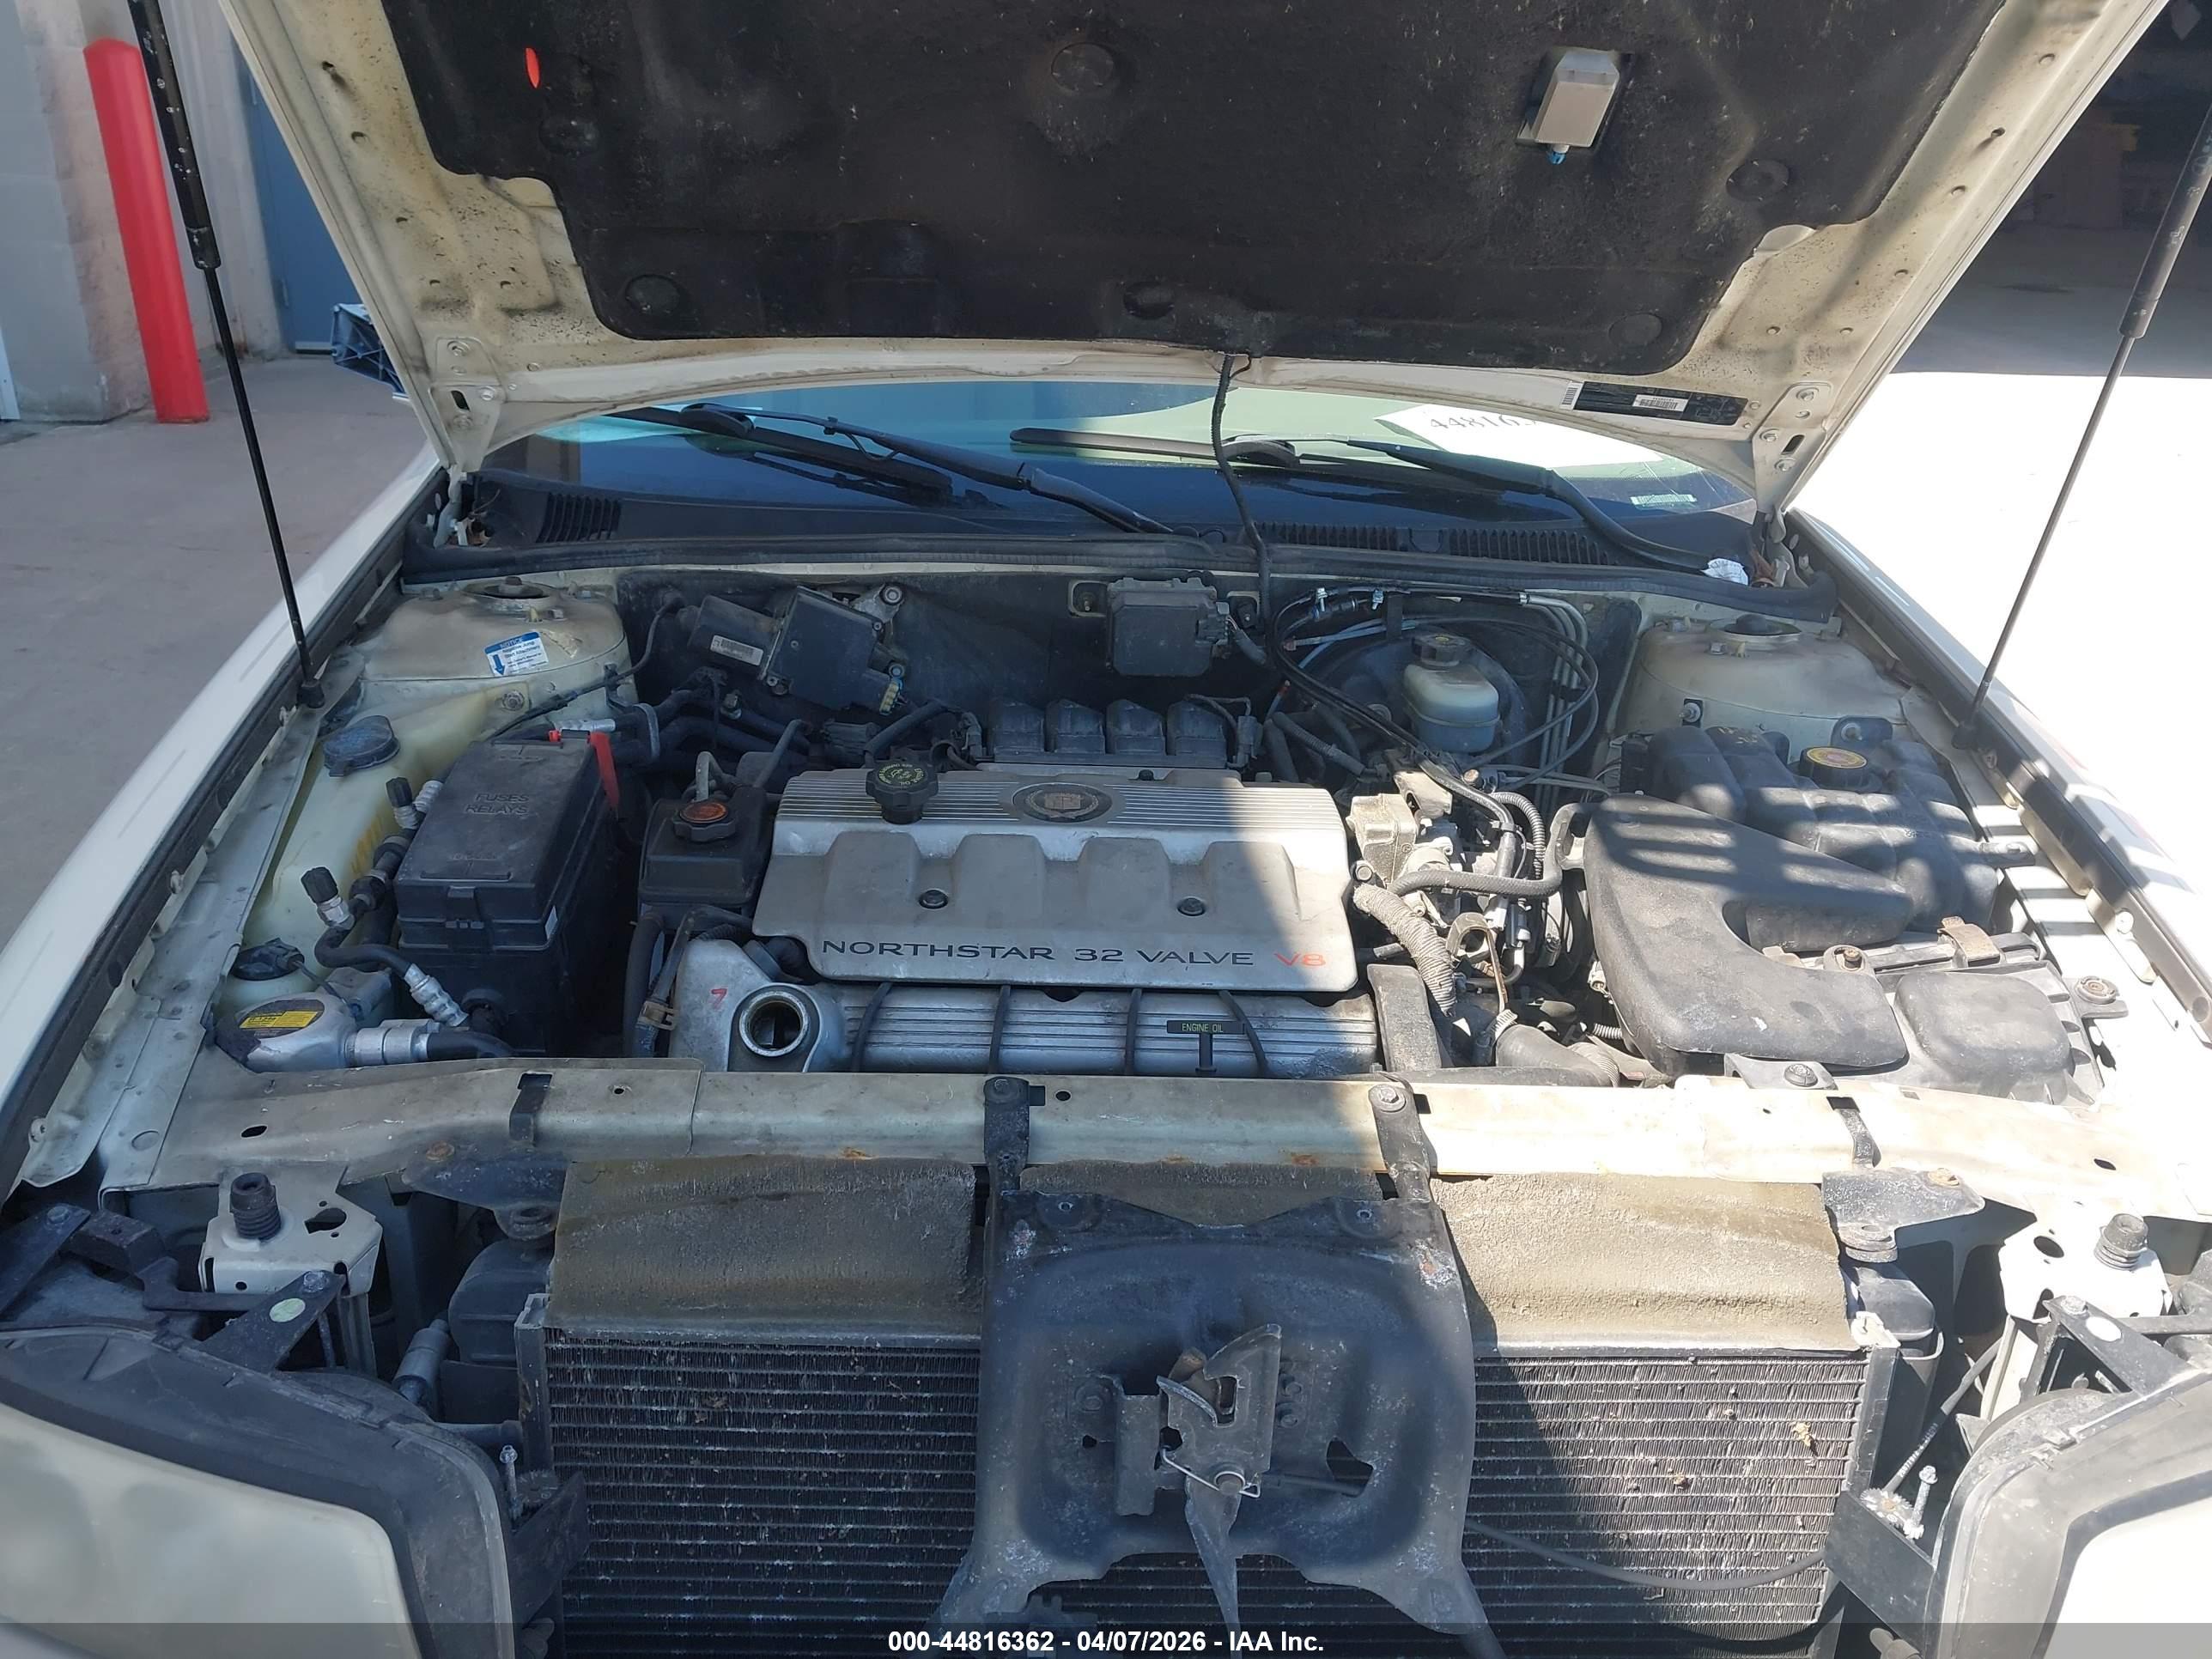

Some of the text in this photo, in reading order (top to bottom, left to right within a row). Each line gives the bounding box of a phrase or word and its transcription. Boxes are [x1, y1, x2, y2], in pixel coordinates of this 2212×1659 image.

[500, 637, 523, 649] NOTICE
[474, 793, 530, 804] FUSES
[465, 804, 529, 816] RELAYS
[823, 940, 1327, 967] NORTHSTAR 32 VALVE V8
[1182, 1023, 1224, 1033] ENGINE OIL
